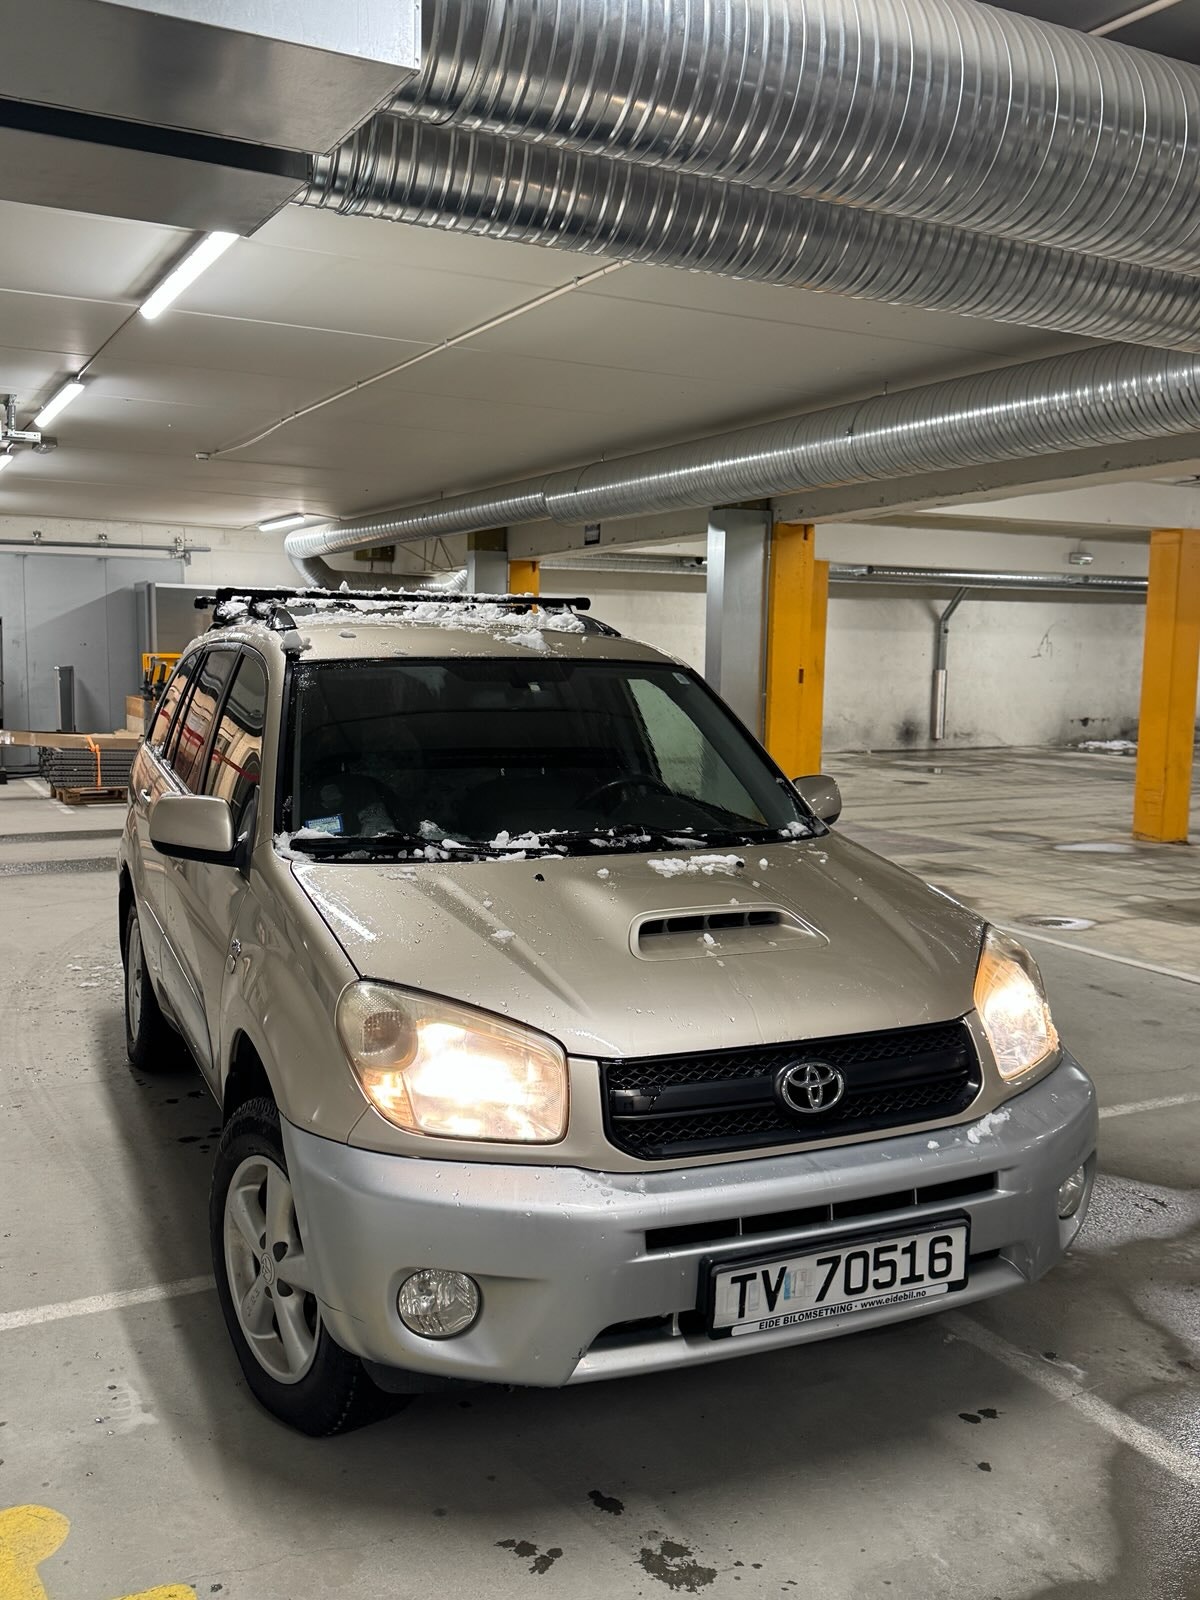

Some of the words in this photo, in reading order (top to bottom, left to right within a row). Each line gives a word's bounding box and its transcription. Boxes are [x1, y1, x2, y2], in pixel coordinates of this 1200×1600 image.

[730, 1266, 788, 1319] TV
[815, 1234, 954, 1303] 70516
[758, 1319, 781, 1331] EIDE
[783, 1303, 854, 1325] BILOMSETNING
[860, 1289, 927, 1309] www.eidebil.no
